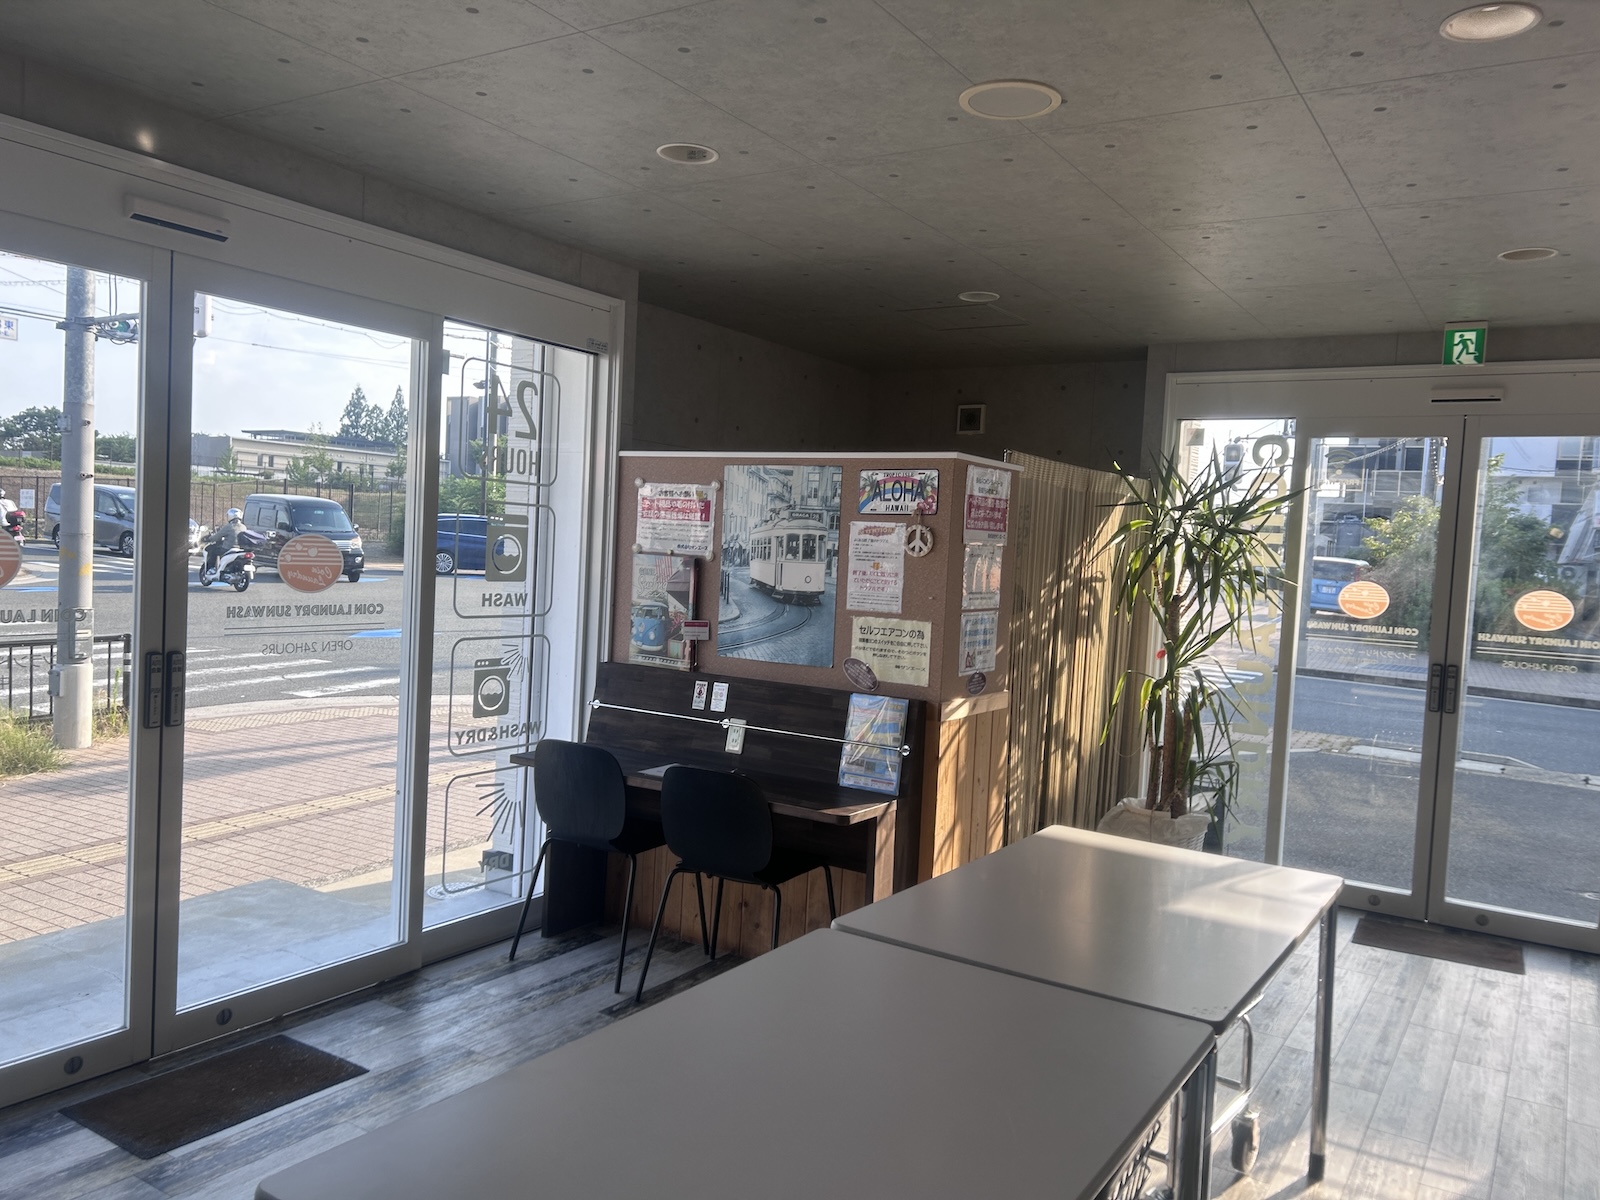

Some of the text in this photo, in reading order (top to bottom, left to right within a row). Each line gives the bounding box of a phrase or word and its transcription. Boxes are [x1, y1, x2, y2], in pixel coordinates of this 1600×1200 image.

[872, 480, 926, 502] ALOHA
[885, 504, 909, 512] HAWAII
[859, 625, 925, 640] セルフエアコンの為
